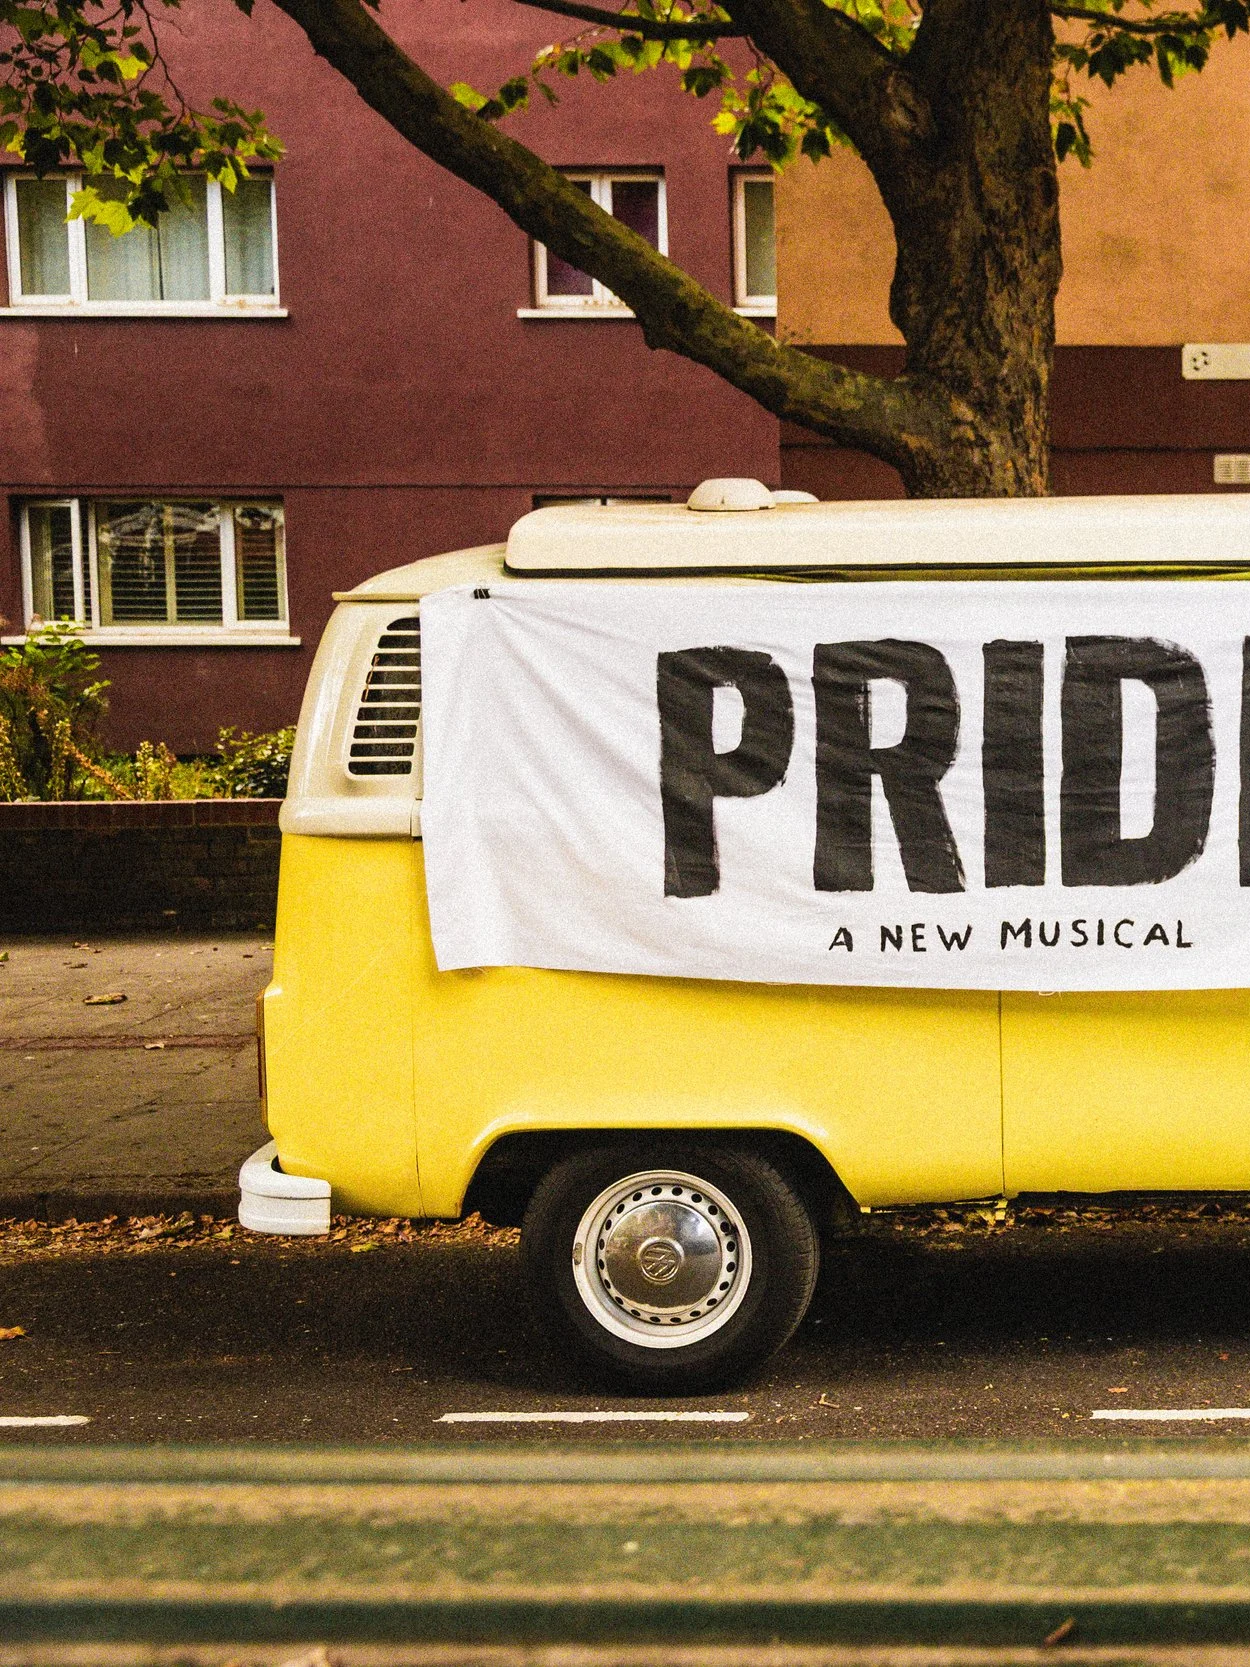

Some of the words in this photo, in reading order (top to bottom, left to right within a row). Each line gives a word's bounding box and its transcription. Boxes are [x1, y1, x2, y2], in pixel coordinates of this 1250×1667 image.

[829, 926, 854, 952] A
[880, 923, 972, 952] NEW
[1000, 917, 1193, 950] MUSICAL
